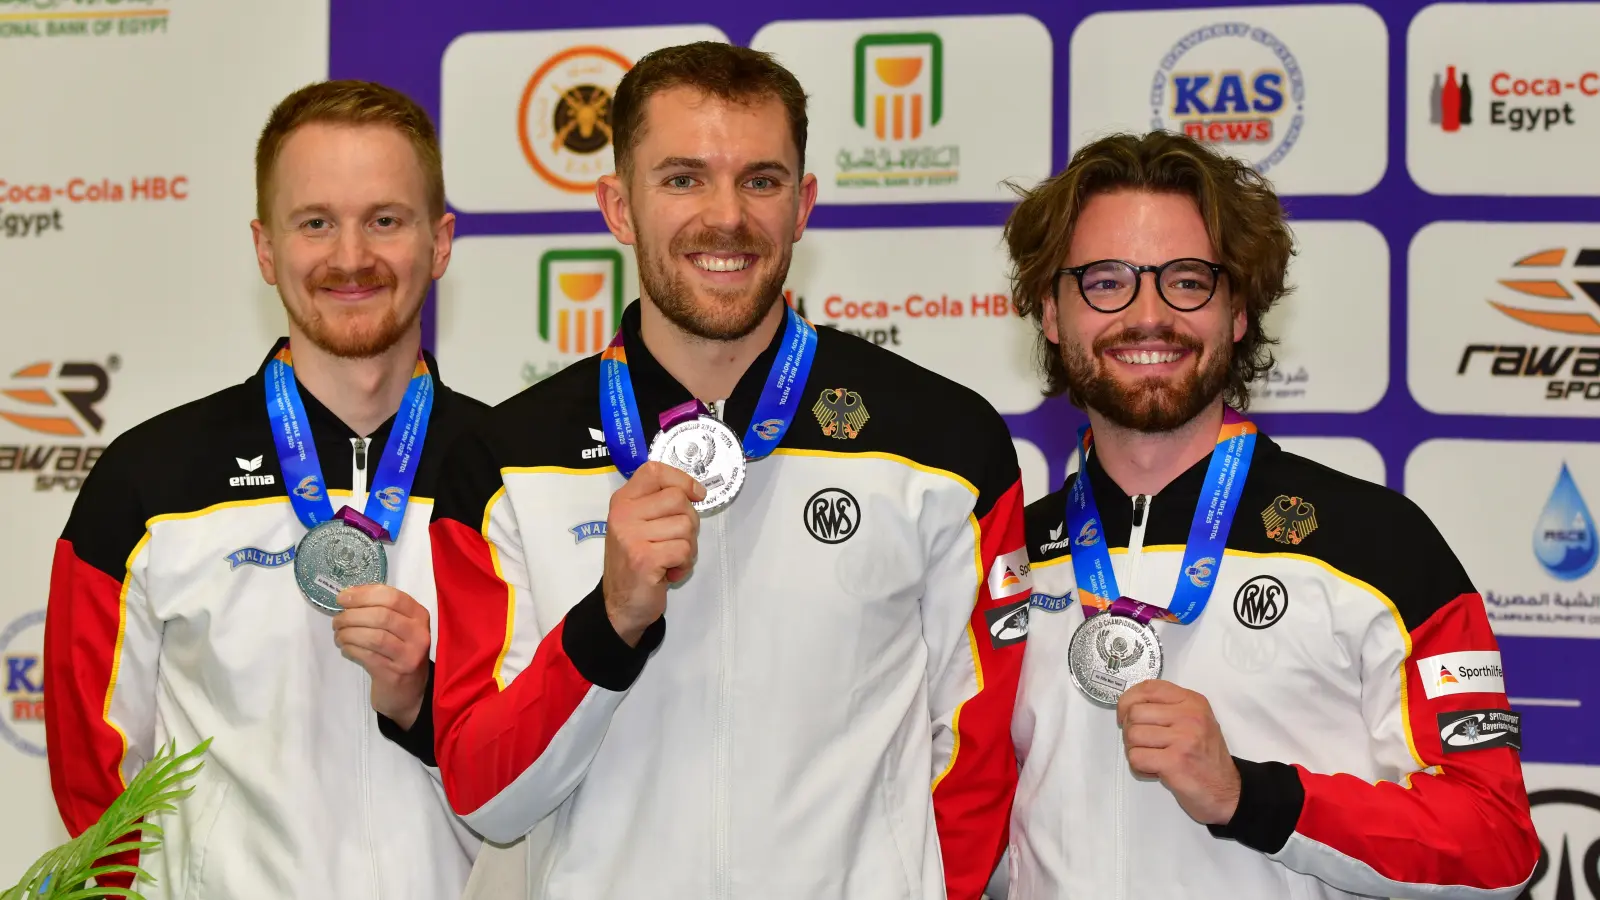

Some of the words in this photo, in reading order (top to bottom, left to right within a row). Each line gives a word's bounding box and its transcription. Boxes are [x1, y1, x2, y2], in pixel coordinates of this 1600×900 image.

[46, 20, 88, 36] BANK
[92, 19, 112, 35] OF
[118, 18, 168, 34] EGYPT
[1174, 74, 1284, 115] KAS
[1491, 101, 1575, 131] Egypt
[1184, 121, 1272, 143] news
[131, 175, 189, 200] HBC
[0, 209, 62, 237] gypt
[824, 295, 964, 319] Coca-Cola
[790, 337, 799, 350] NOV
[781, 361, 790, 374] NOV
[787, 366, 797, 383] RIFLE
[776, 374, 785, 389] 2025
[276, 396, 285, 411] NOV
[778, 385, 790, 406] PISTOL
[279, 376, 295, 420] CHAMPIONSHIP
[291, 420, 300, 437] RIFLE
[296, 440, 306, 461] PISTOL
[410, 395, 426, 435] CHAMPIONSHIP
[613, 374, 628, 416] CHAMPIONSHIP
[623, 416, 632, 434] RIFLE
[628, 437, 637, 458] PISTOL
[283, 421, 291, 435] NOV
[614, 417, 622, 431] NOV
[286, 434, 295, 449] 2025
[401, 429, 409, 442] NOV
[406, 434, 415, 450] RIFLE
[617, 431, 626, 445] 2025
[396, 442, 405, 456] 2025
[1234, 438, 1245, 457] WORLD
[398, 453, 408, 473] PISTOL
[1222, 454, 1231, 467] EGY
[229, 473, 275, 487] erima
[1217, 472, 1226, 485] NOV
[1221, 456, 1239, 499] CHAMPIONSHIP
[1213, 488, 1220, 496] 18
[1209, 496, 1218, 509] NOV
[1216, 499, 1226, 516] RIFLE
[812, 497, 852, 539] RWS
[1204, 509, 1214, 524] 2025
[1208, 519, 1220, 541] PISTOL
[1040, 538, 1069, 555] erima
[236, 552, 291, 565] WALTHER
[1093, 558, 1101, 570] ISSF
[1088, 574, 1099, 592] CAIRO,
[1096, 570, 1106, 589] WORLD
[1030, 595, 1067, 609] ALTHER
[1240, 584, 1281, 624] RWS
[1102, 618, 1143, 635] CHAMPIONSHIP
[1458, 664, 1503, 680] Sporthilfe
